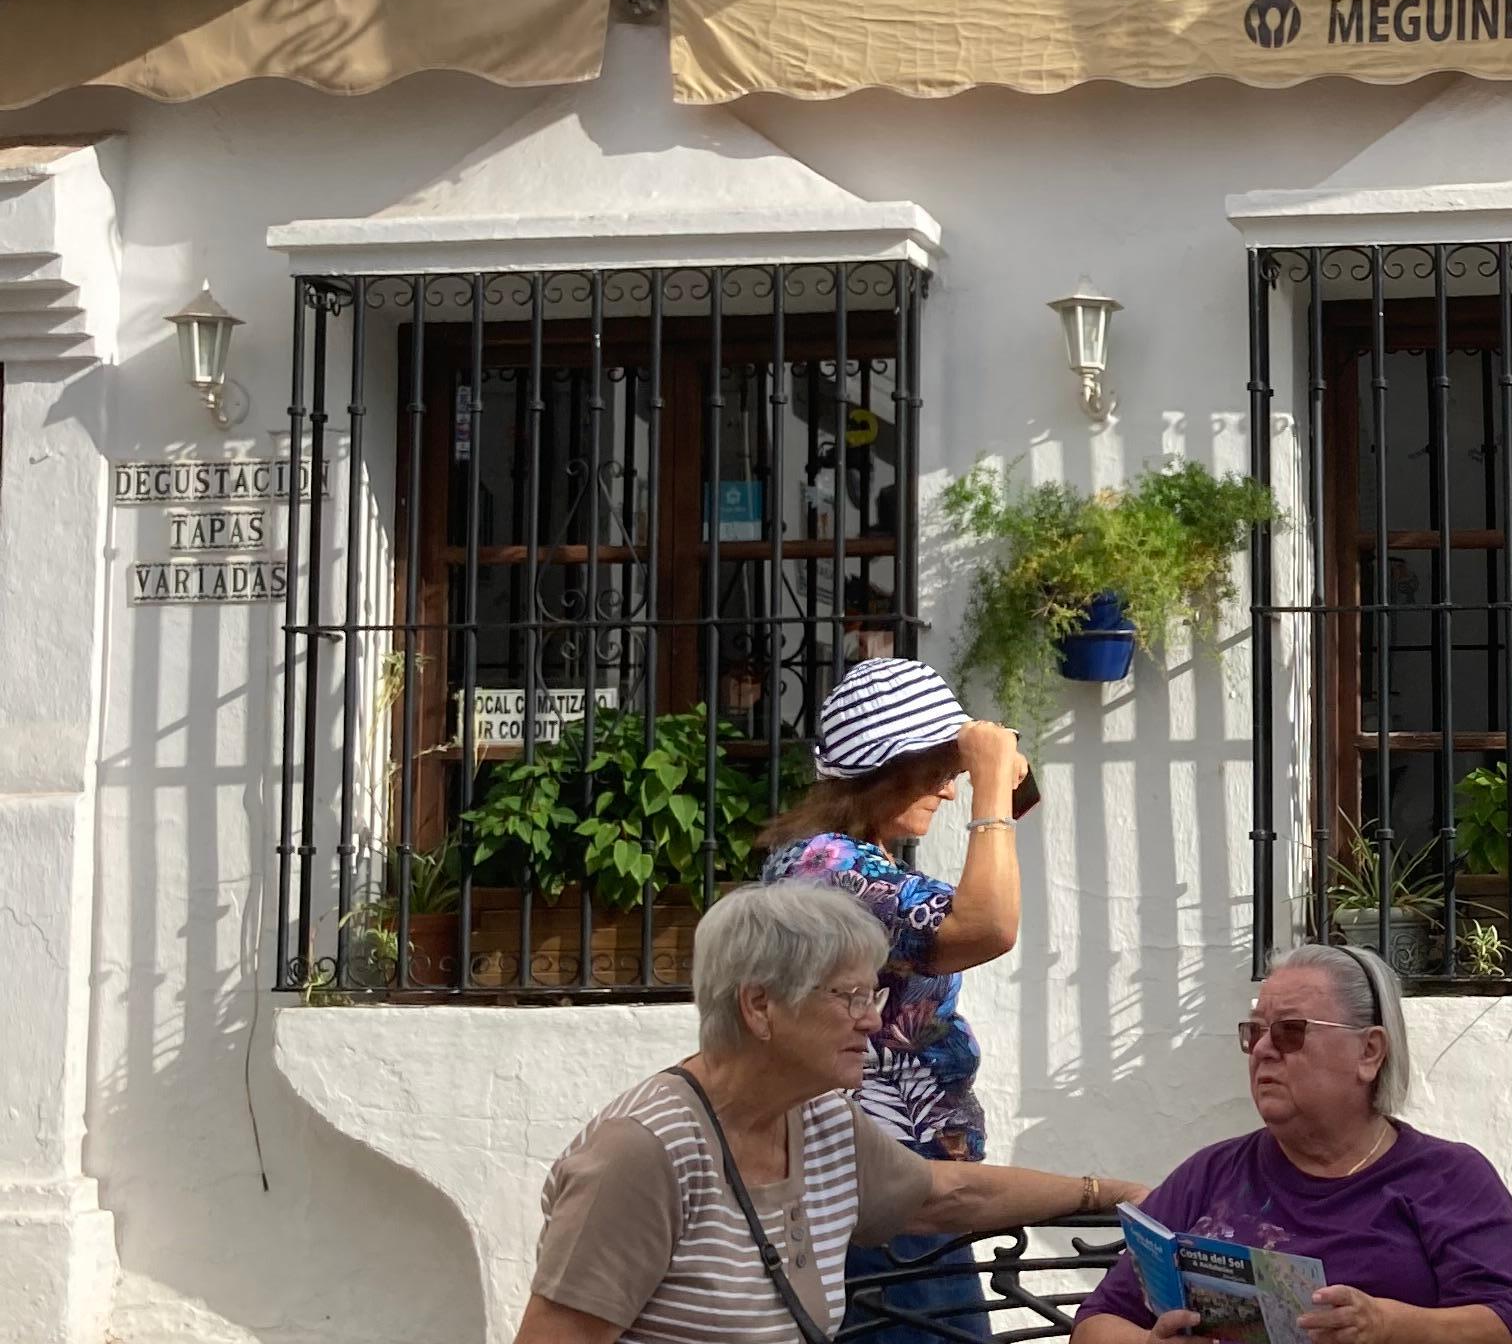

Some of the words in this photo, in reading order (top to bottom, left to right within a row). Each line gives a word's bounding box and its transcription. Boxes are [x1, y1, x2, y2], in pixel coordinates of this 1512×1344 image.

[172, 517, 264, 545] TAPAS
[136, 567, 286, 594] VARIADAS
[475, 695, 511, 714] OCAL
[515, 694, 608, 714] CMATIZAO
[1180, 1248, 1208, 1262] Costa
[1210, 1254, 1226, 1265] del
[1228, 1257, 1245, 1269] Sol
